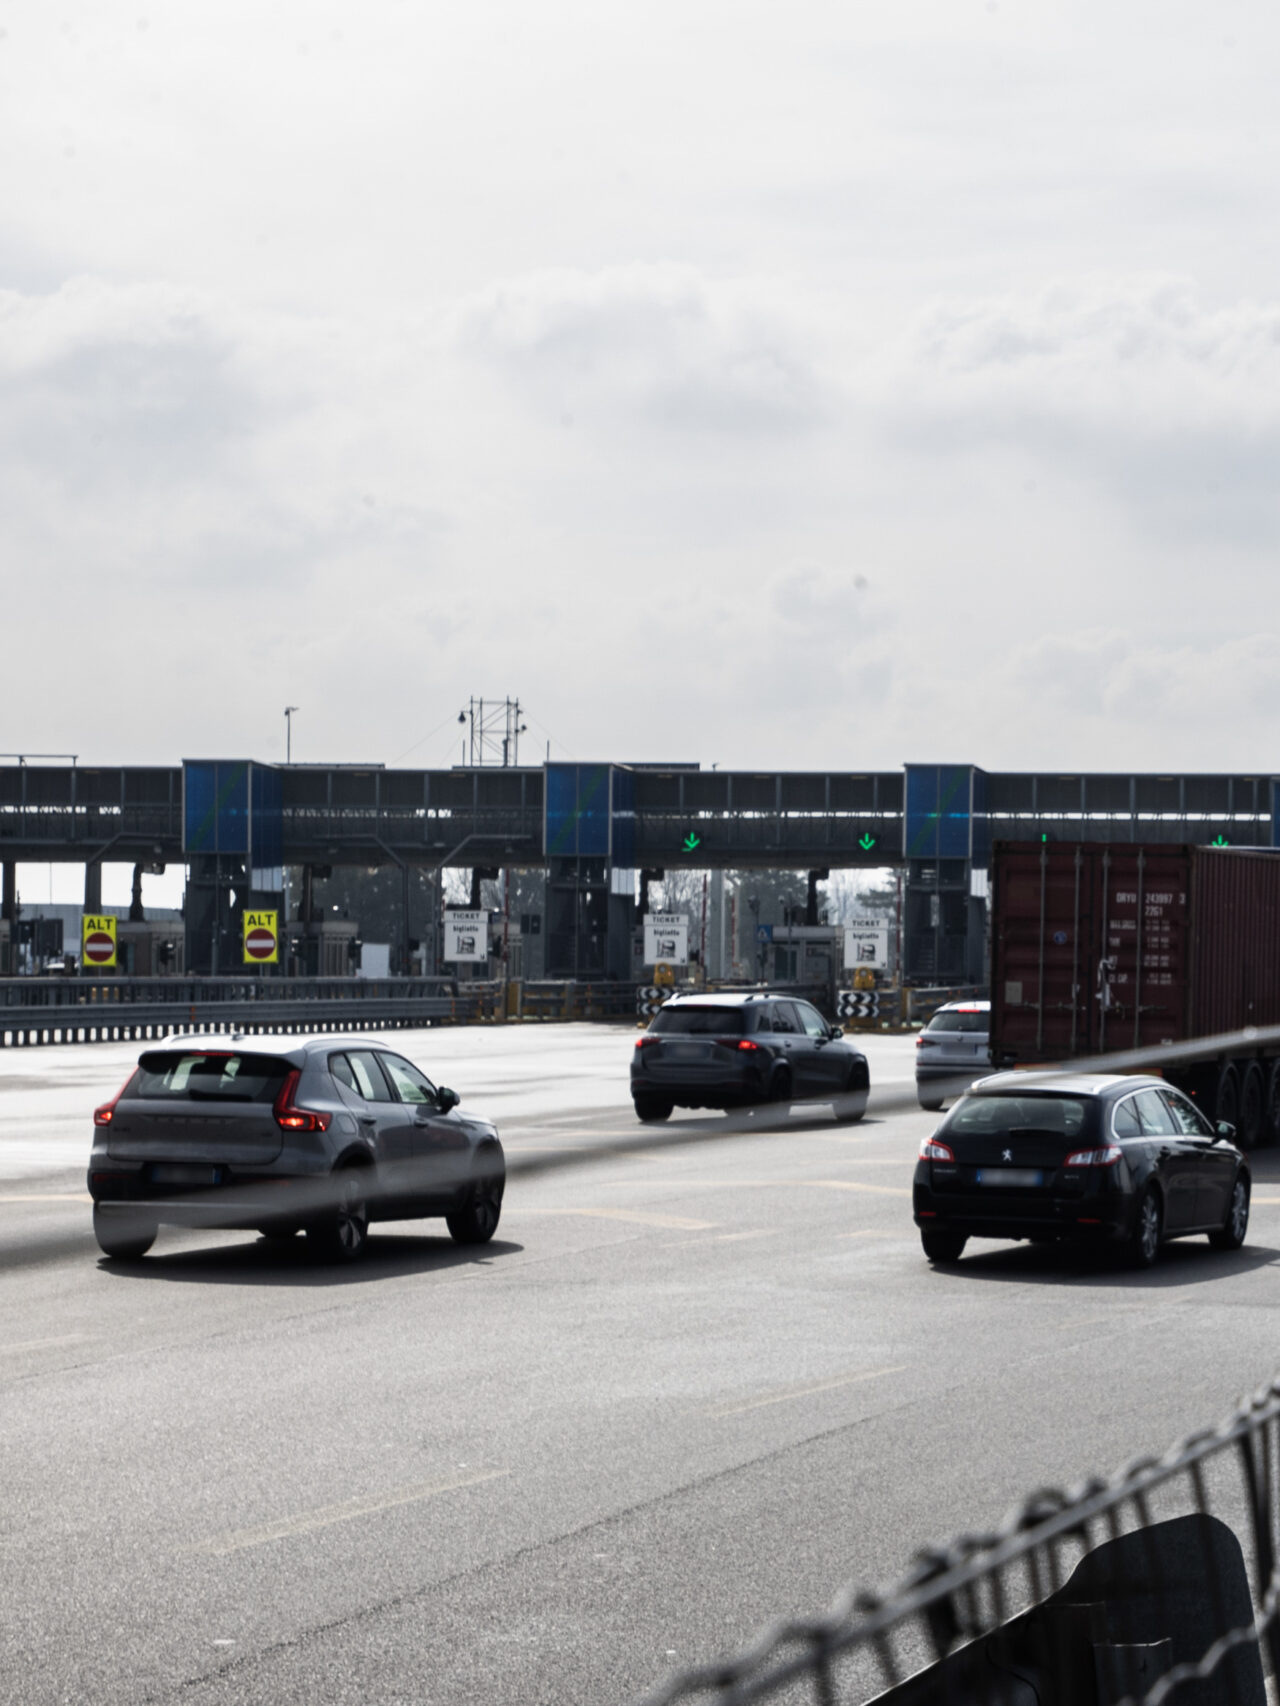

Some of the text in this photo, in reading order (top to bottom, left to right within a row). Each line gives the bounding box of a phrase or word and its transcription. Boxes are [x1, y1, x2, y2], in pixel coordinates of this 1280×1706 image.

[87, 918, 113, 930] ALT
[247, 914, 274, 926] ALT
[453, 924, 479, 933] biglietto
[653, 928, 680, 937] biglietto
[853, 932, 879, 941] biglietto
